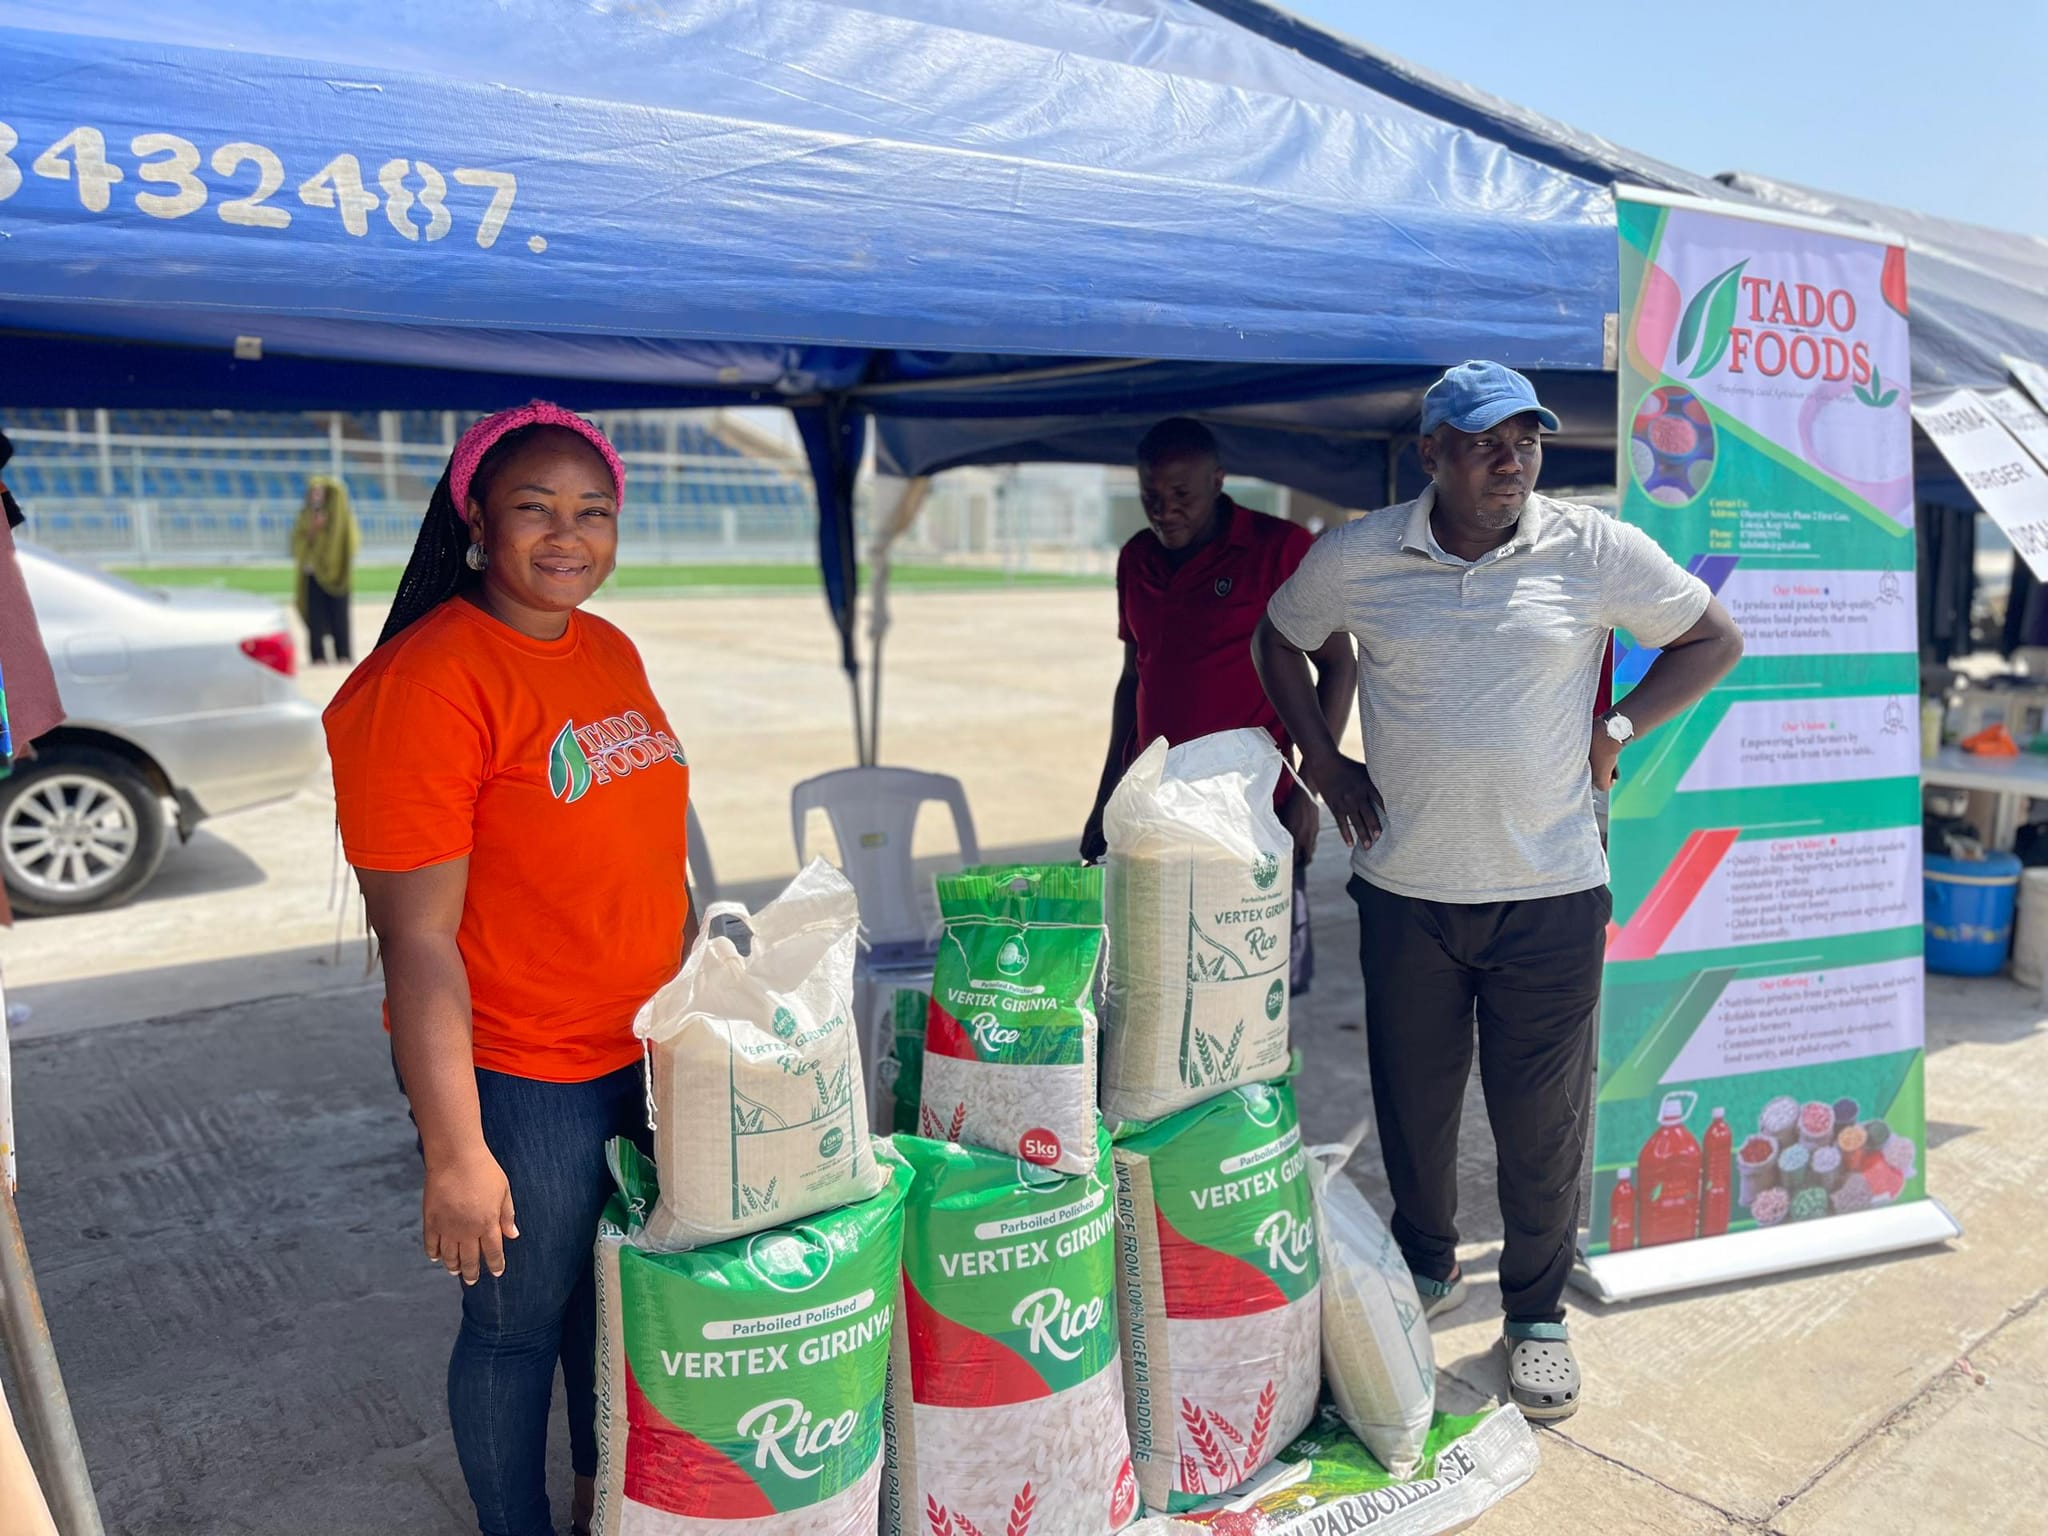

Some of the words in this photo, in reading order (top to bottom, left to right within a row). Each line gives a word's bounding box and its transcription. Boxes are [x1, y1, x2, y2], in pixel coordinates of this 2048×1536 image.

[1741, 276, 1857, 333] TADO
[1729, 327, 1871, 385] FOODS
[574, 711, 650, 752] TADO
[1214, 908, 1263, 925] VERTEX
[1245, 926, 1278, 961] Rice
[948, 988, 998, 1008] VERTEX
[1001, 997, 1058, 1013] GIRINYA
[741, 1042, 791, 1056] VERTEX
[971, 1012, 1021, 1053] Rice
[1025, 1139, 1058, 1158] 5kg
[1240, 1145, 1279, 1167] Parboiled
[1190, 1168, 1279, 1211] VERTEX
[1000, 1212, 1057, 1236] Parboiled
[1059, 1199, 1094, 1225] Polished
[1120, 1198, 1136, 1230] RICE
[939, 1239, 1050, 1278] VERTEX
[1123, 1235, 1139, 1277] FROM
[1254, 1210, 1313, 1274] Rice
[732, 1315, 801, 1336] Parboiled
[806, 1299, 857, 1325] Polished
[1127, 1281, 1144, 1318] 100%
[660, 1343, 789, 1379] VERTEX
[798, 1304, 891, 1367] GIRINYA
[1012, 1287, 1104, 1362] Rice
[600, 1334, 611, 1373] RICE
[1131, 1322, 1151, 1383] NIGERIA
[737, 1398, 860, 1480] Rice
[885, 1400, 899, 1469] NIGERIA
